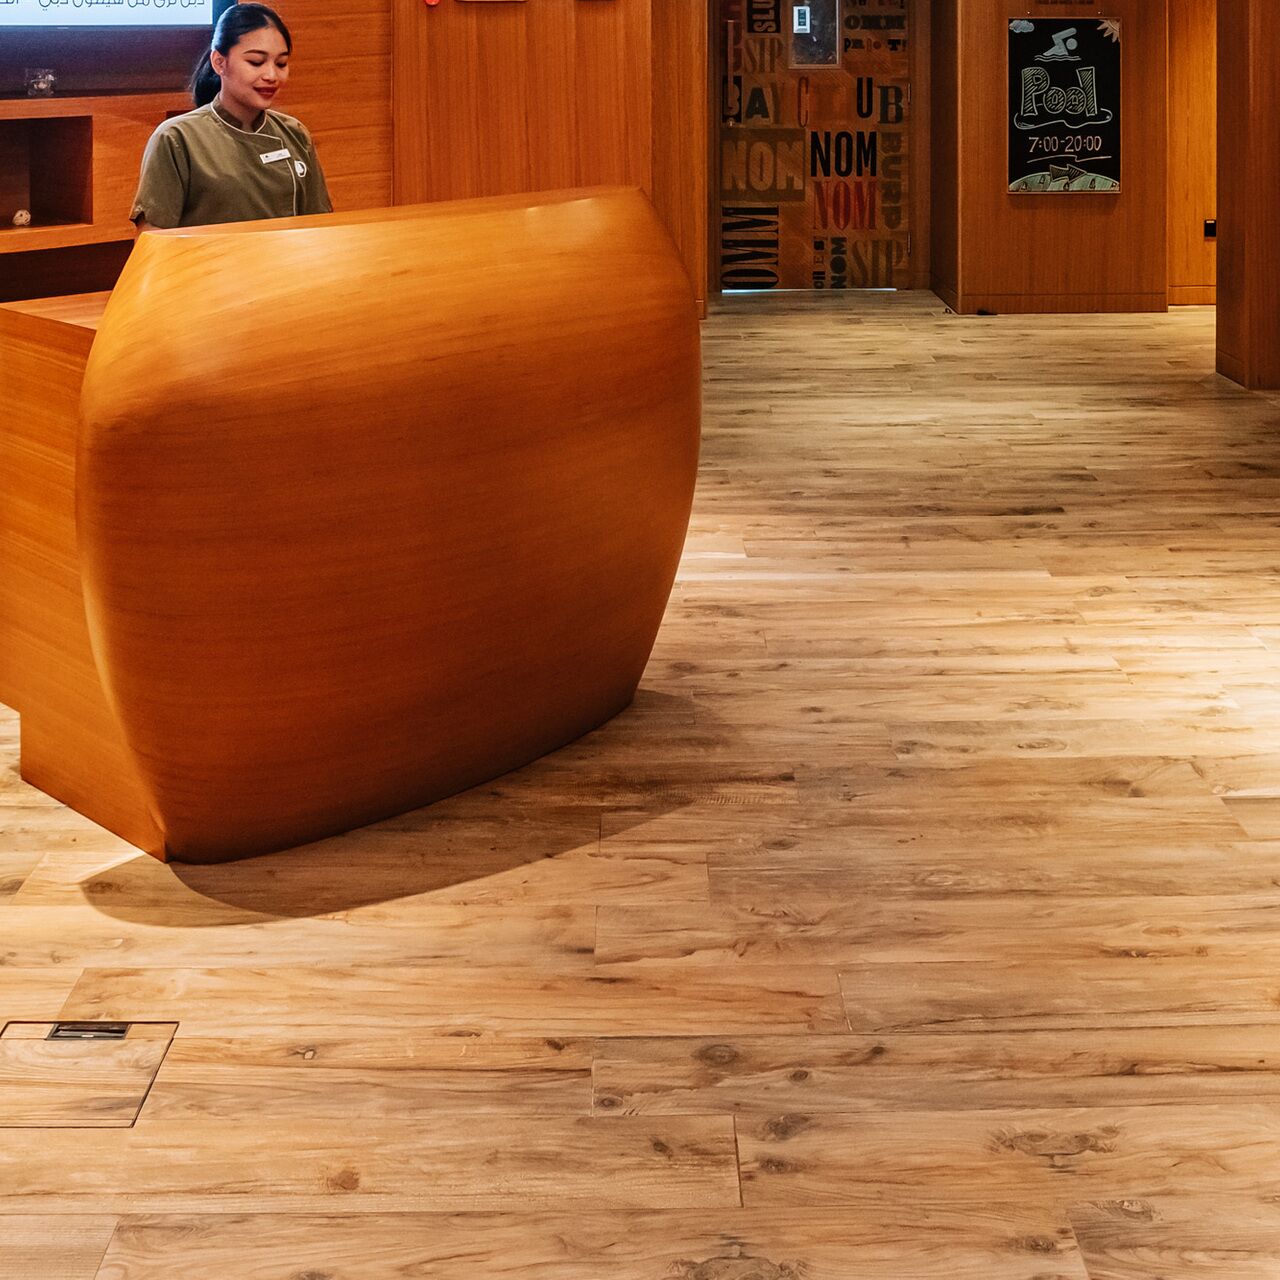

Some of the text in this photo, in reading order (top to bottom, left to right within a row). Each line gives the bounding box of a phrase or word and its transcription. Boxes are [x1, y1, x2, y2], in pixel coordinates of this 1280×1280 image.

[1021, 66, 1098, 117] Pool
[722, 139, 804, 191] NOM
[810, 131, 877, 177] NOM
[1028, 135, 1102, 153] 7:00-20:00
[813, 180, 877, 231] NOM
[721, 205, 780, 290] OMM
